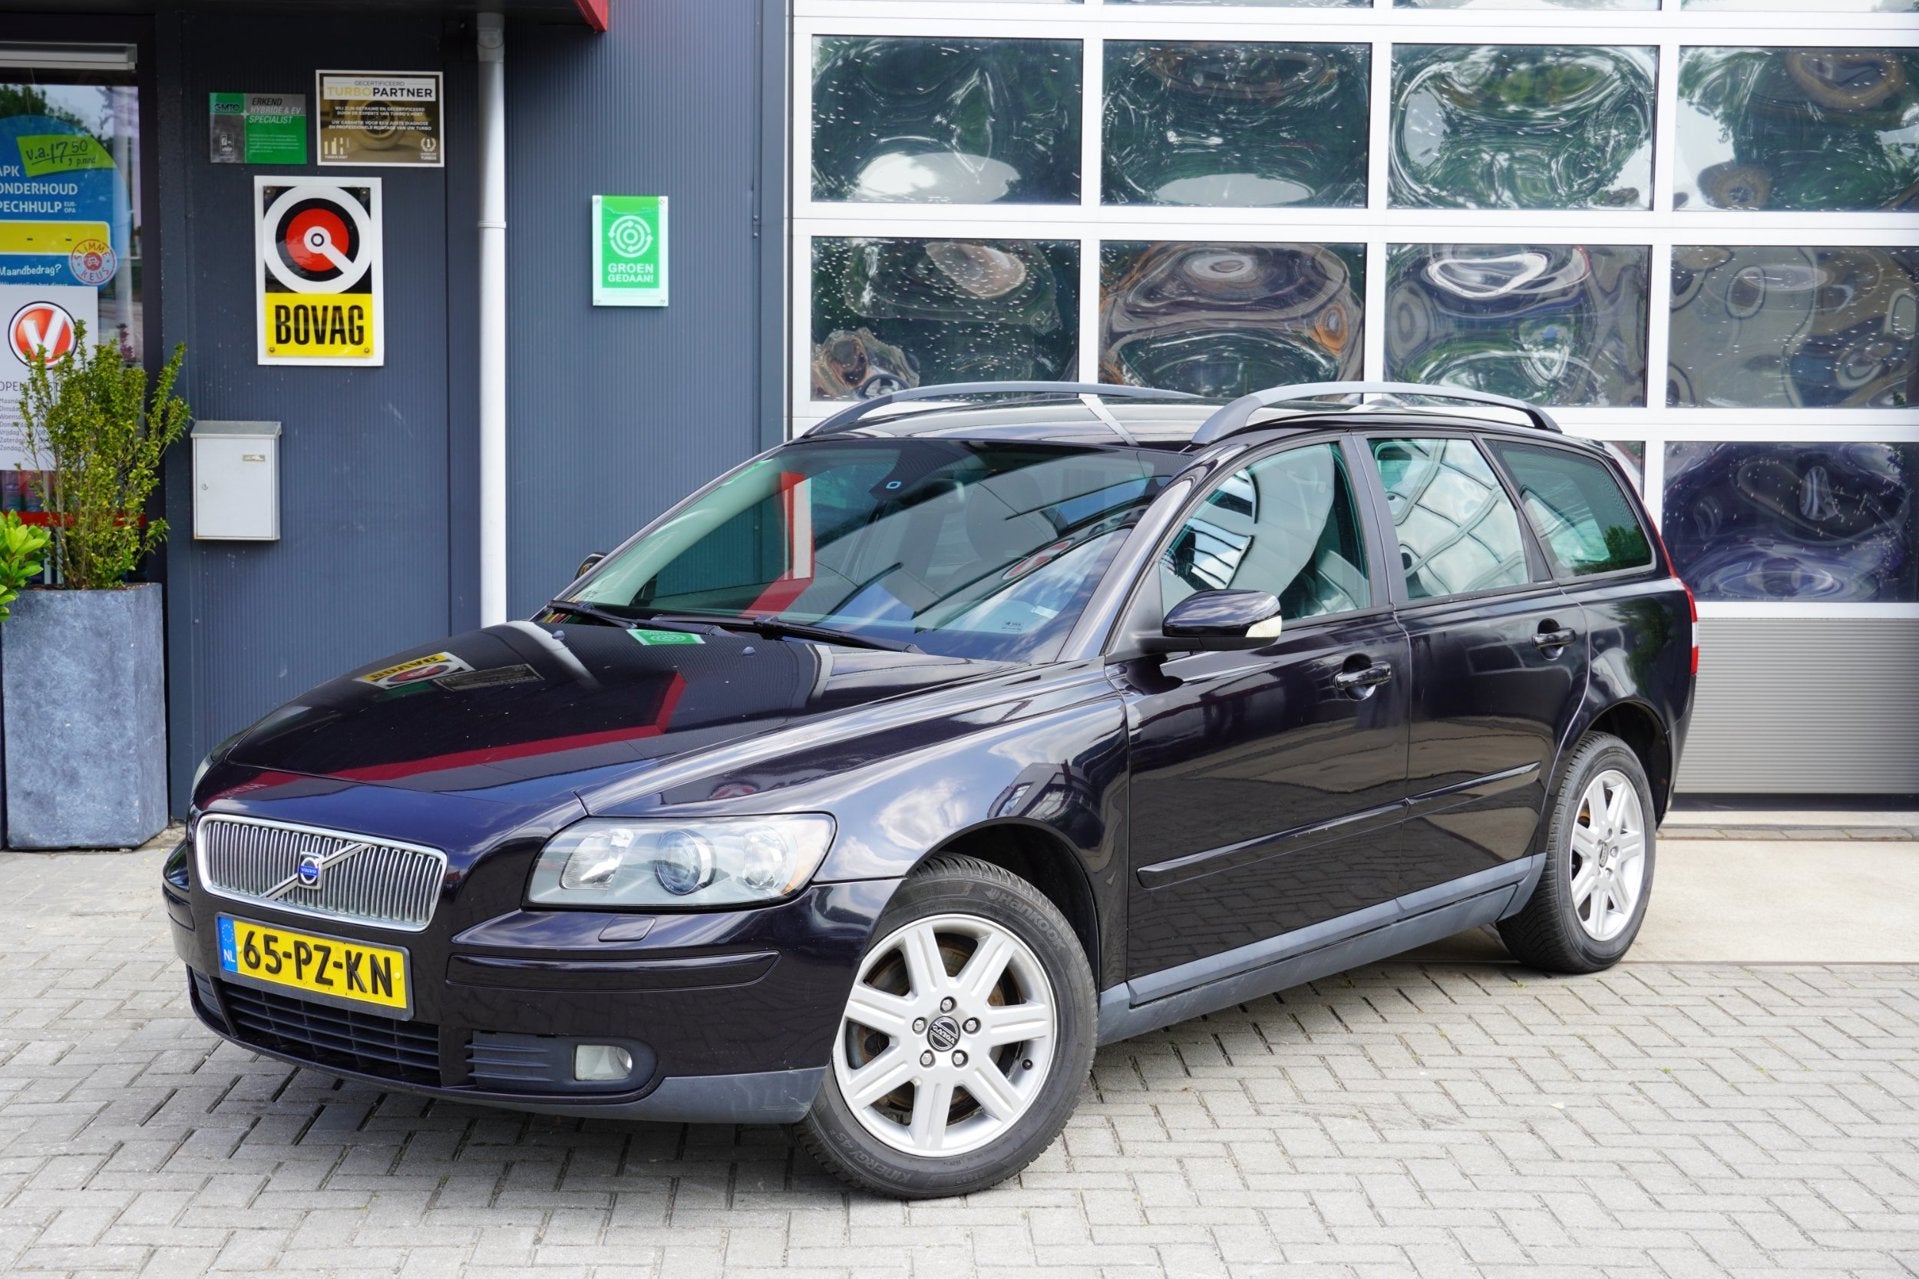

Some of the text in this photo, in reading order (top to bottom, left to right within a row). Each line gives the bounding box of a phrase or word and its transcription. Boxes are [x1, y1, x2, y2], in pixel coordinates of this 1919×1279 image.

[327, 86, 433, 98] TURBOPARTNER
[251, 97, 283, 106] ERKEND
[250, 105, 283, 114] HYBRIDE
[291, 106, 302, 115] EV
[249, 115, 293, 124] SPECIALIST
[607, 263, 654, 274] GROEN
[607, 274, 654, 283] GEDAAN!
[275, 304, 364, 346] BOVAG
[223, 948, 235, 963] NL
[243, 930, 393, 998] 65-PZ-KN
[932, 1025, 955, 1044] VOLVO
